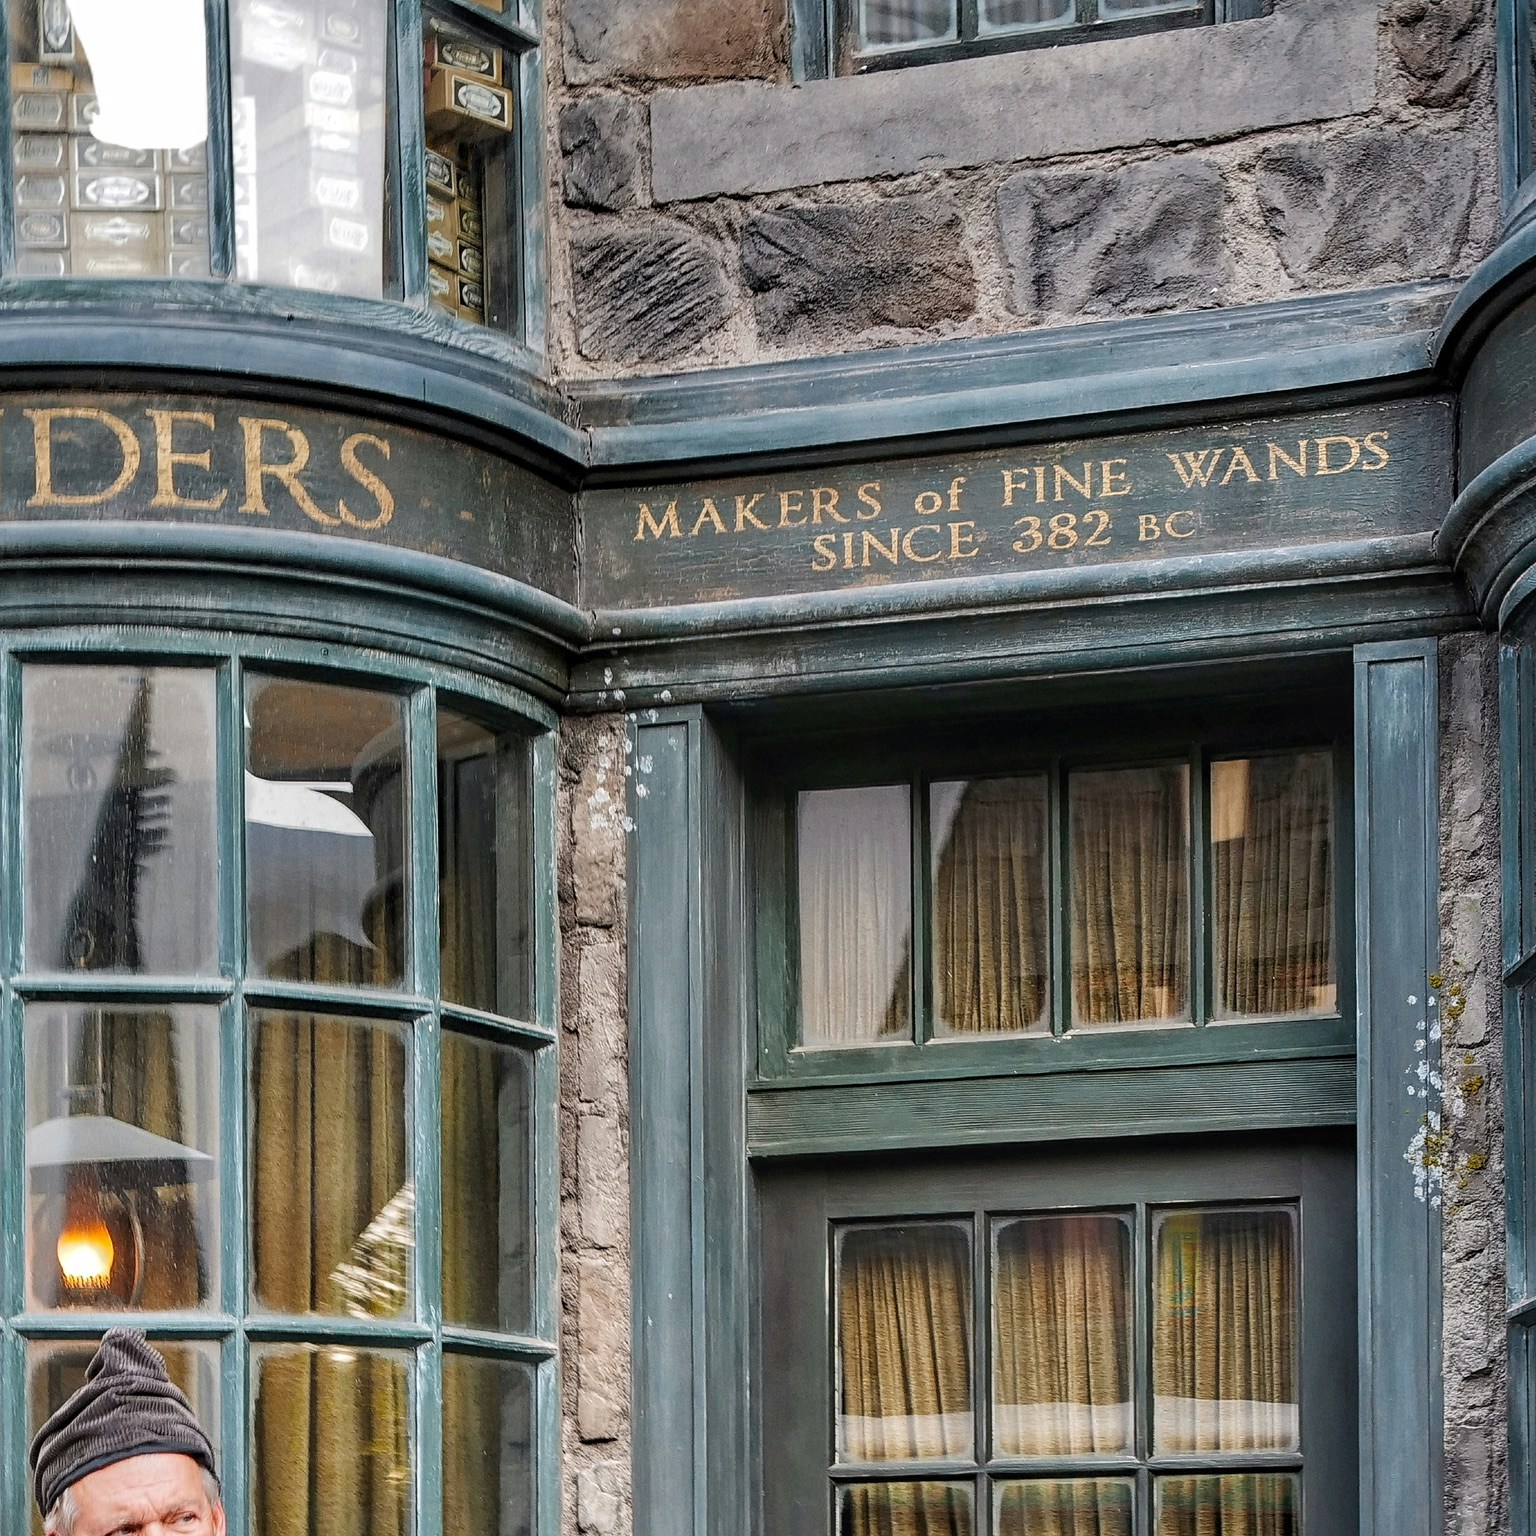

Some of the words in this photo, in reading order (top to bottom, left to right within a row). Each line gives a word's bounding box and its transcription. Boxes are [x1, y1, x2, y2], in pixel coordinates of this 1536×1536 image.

[633, 481, 882, 542] MAKERS
[913, 476, 967, 517] of
[1001, 457, 1133, 509] FINE
[1166, 430, 1392, 489] WANDS
[810, 520, 978, 572] SINCE
[1012, 512, 1112, 554] 382
[1138, 509, 1197, 543] BC
